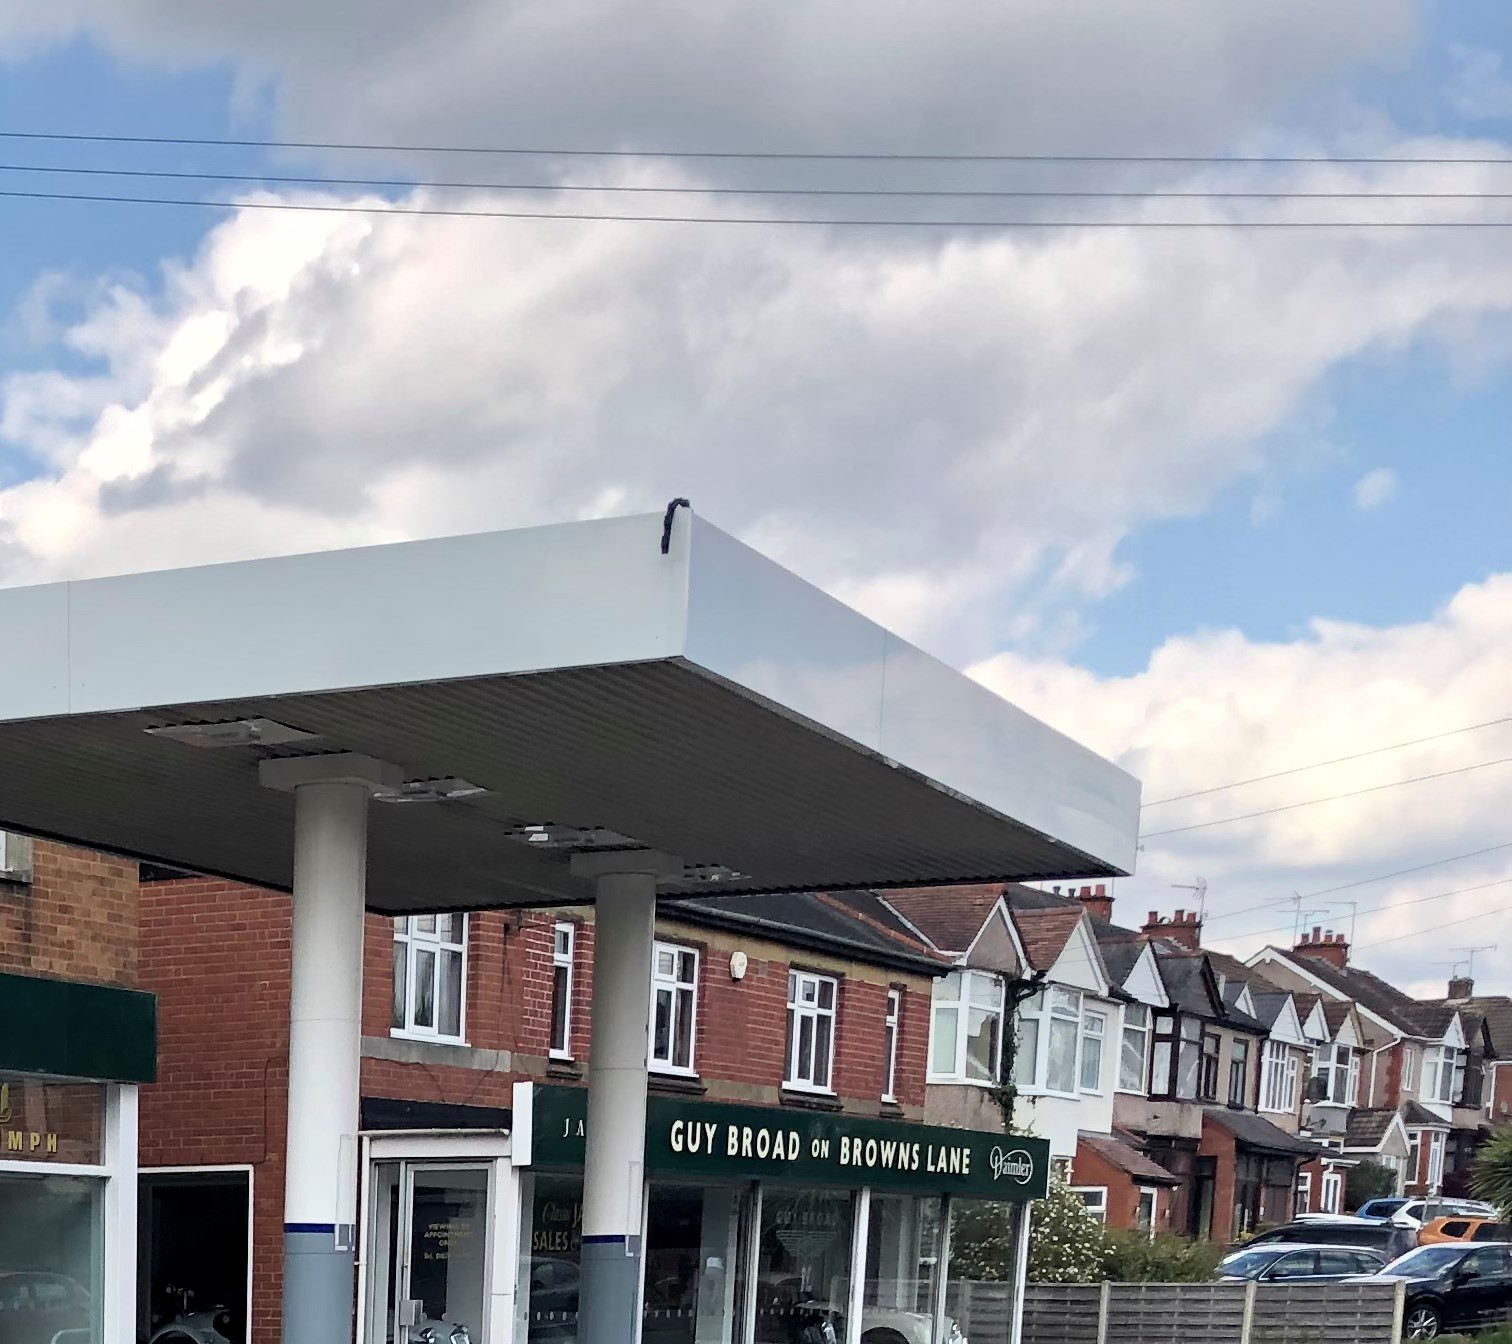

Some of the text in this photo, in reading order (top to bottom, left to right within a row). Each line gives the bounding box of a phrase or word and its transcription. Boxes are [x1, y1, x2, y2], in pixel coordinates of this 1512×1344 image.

[670, 1120, 971, 1174] GUY BROAD ON BROWNS LANE
[990, 1146, 1033, 1184] Daimler
[533, 1231, 568, 1251] SALES
